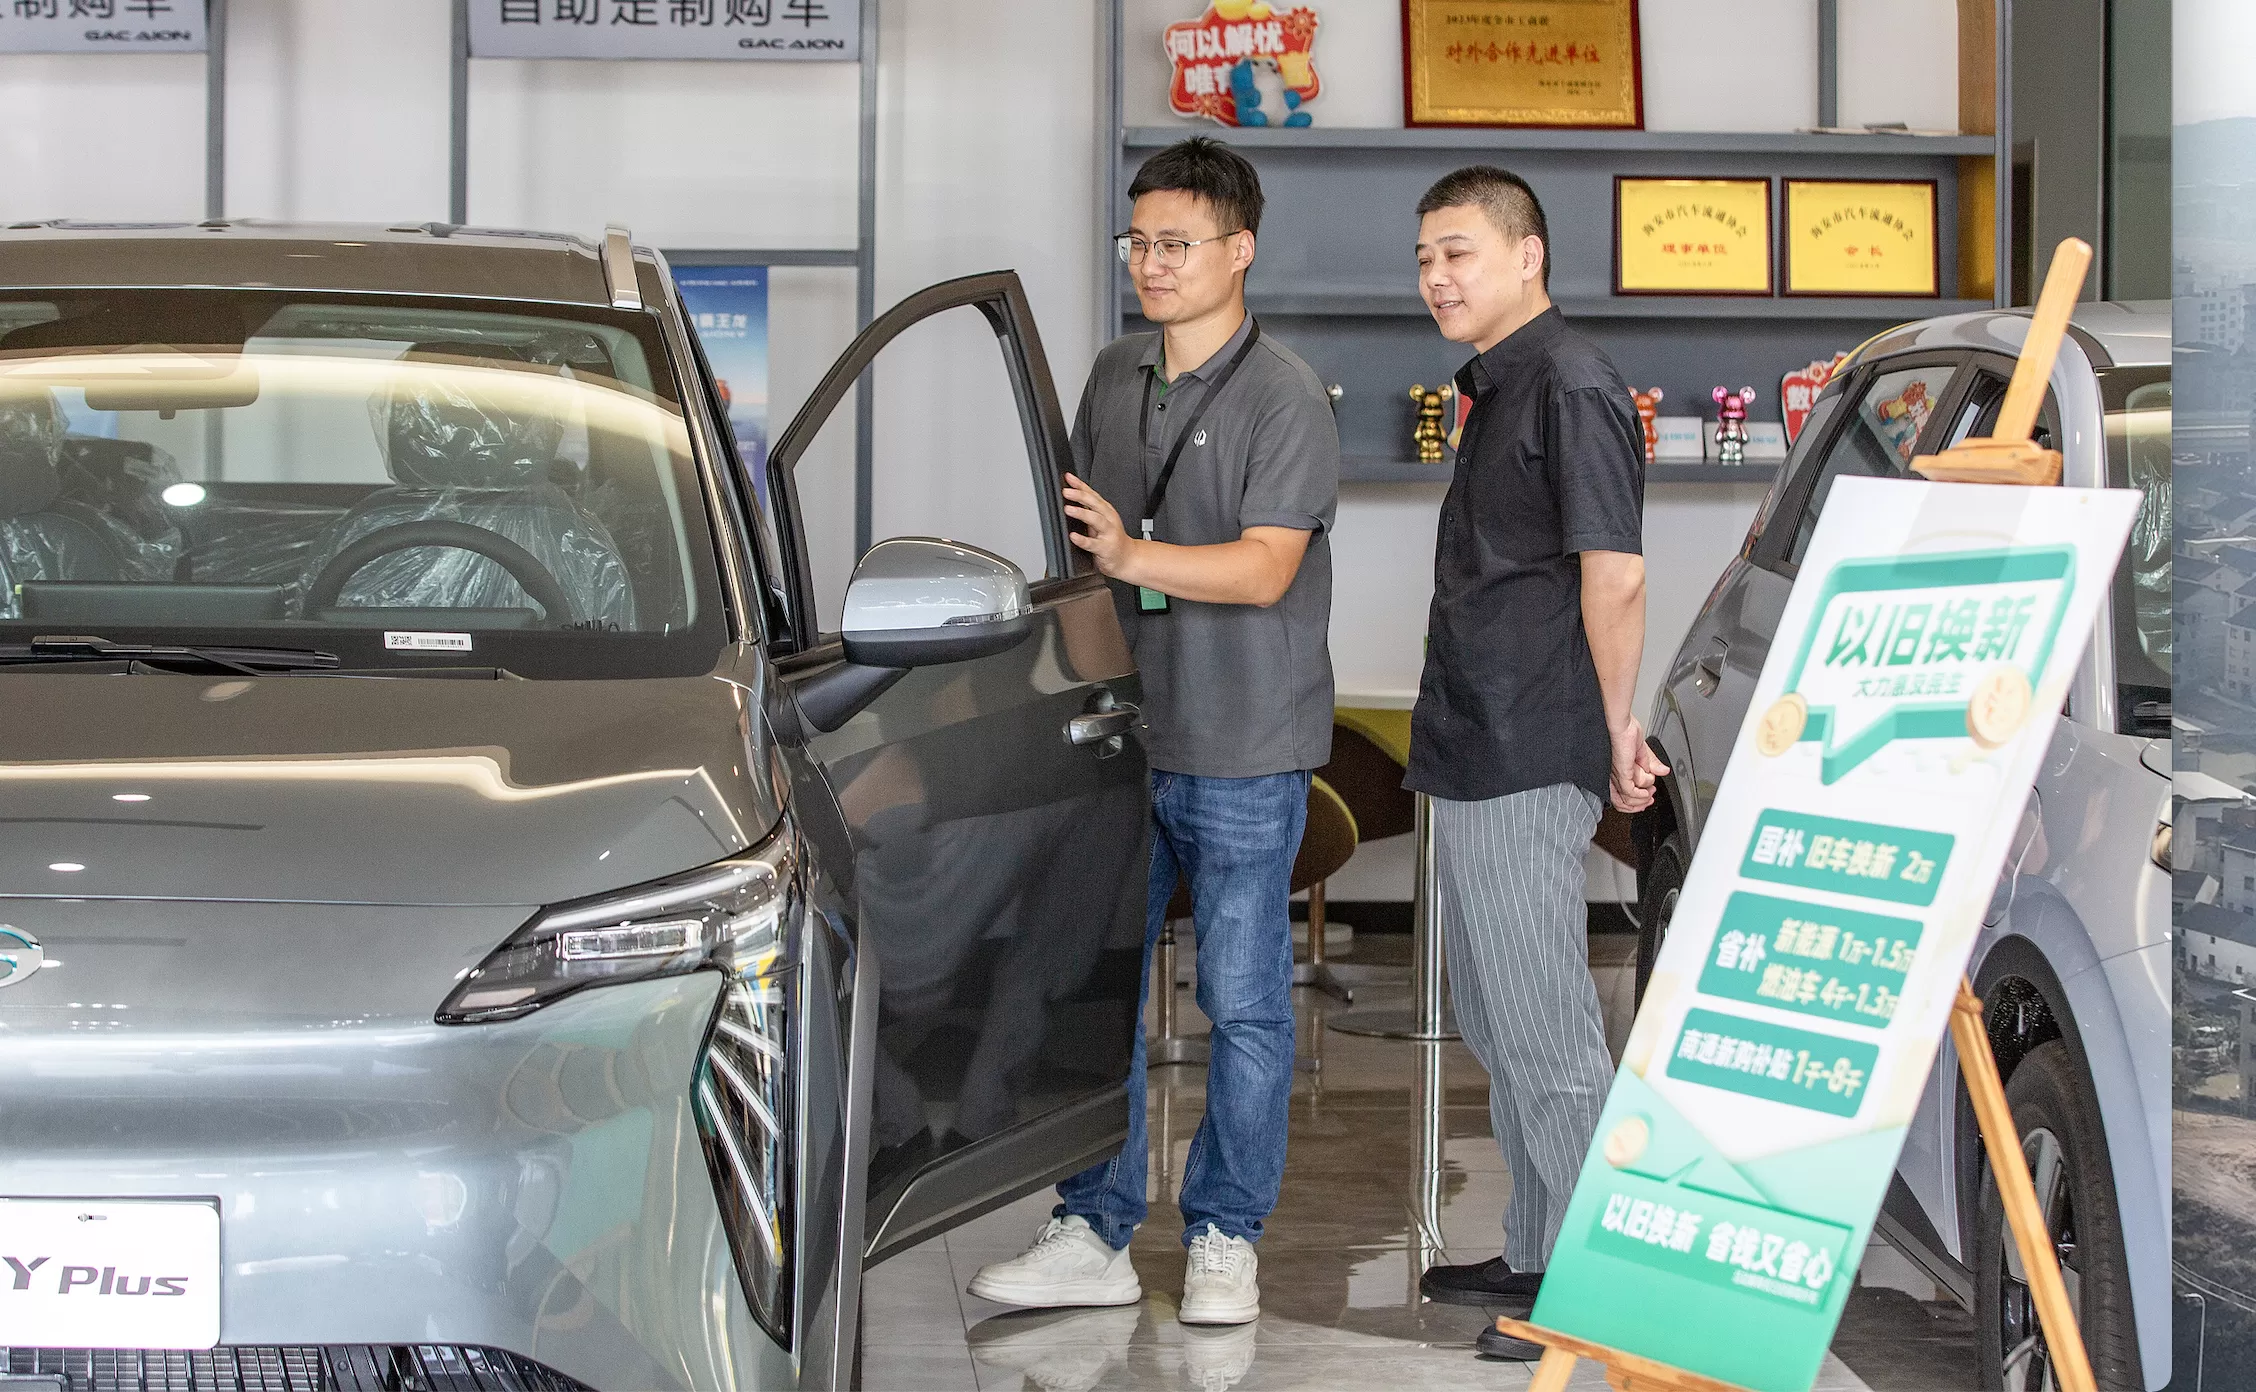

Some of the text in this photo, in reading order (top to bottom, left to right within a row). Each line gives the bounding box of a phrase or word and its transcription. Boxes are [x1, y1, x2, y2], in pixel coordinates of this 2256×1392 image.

[84, 30, 192, 41] GAC AION
[738, 38, 845, 50] GAC AION
[1167, 20, 1286, 61] 何以解忧
[1824, 594, 2038, 668] 以旧换新
[1751, 824, 1805, 868] 国补
[1804, 834, 1900, 881] 旧车换新
[1715, 928, 1768, 974] 省补
[1600, 1192, 1704, 1254] 以旧换新
[1705, 1220, 1834, 1289] 省钱又省心
[2, 1256, 189, 1296] Y Plus
